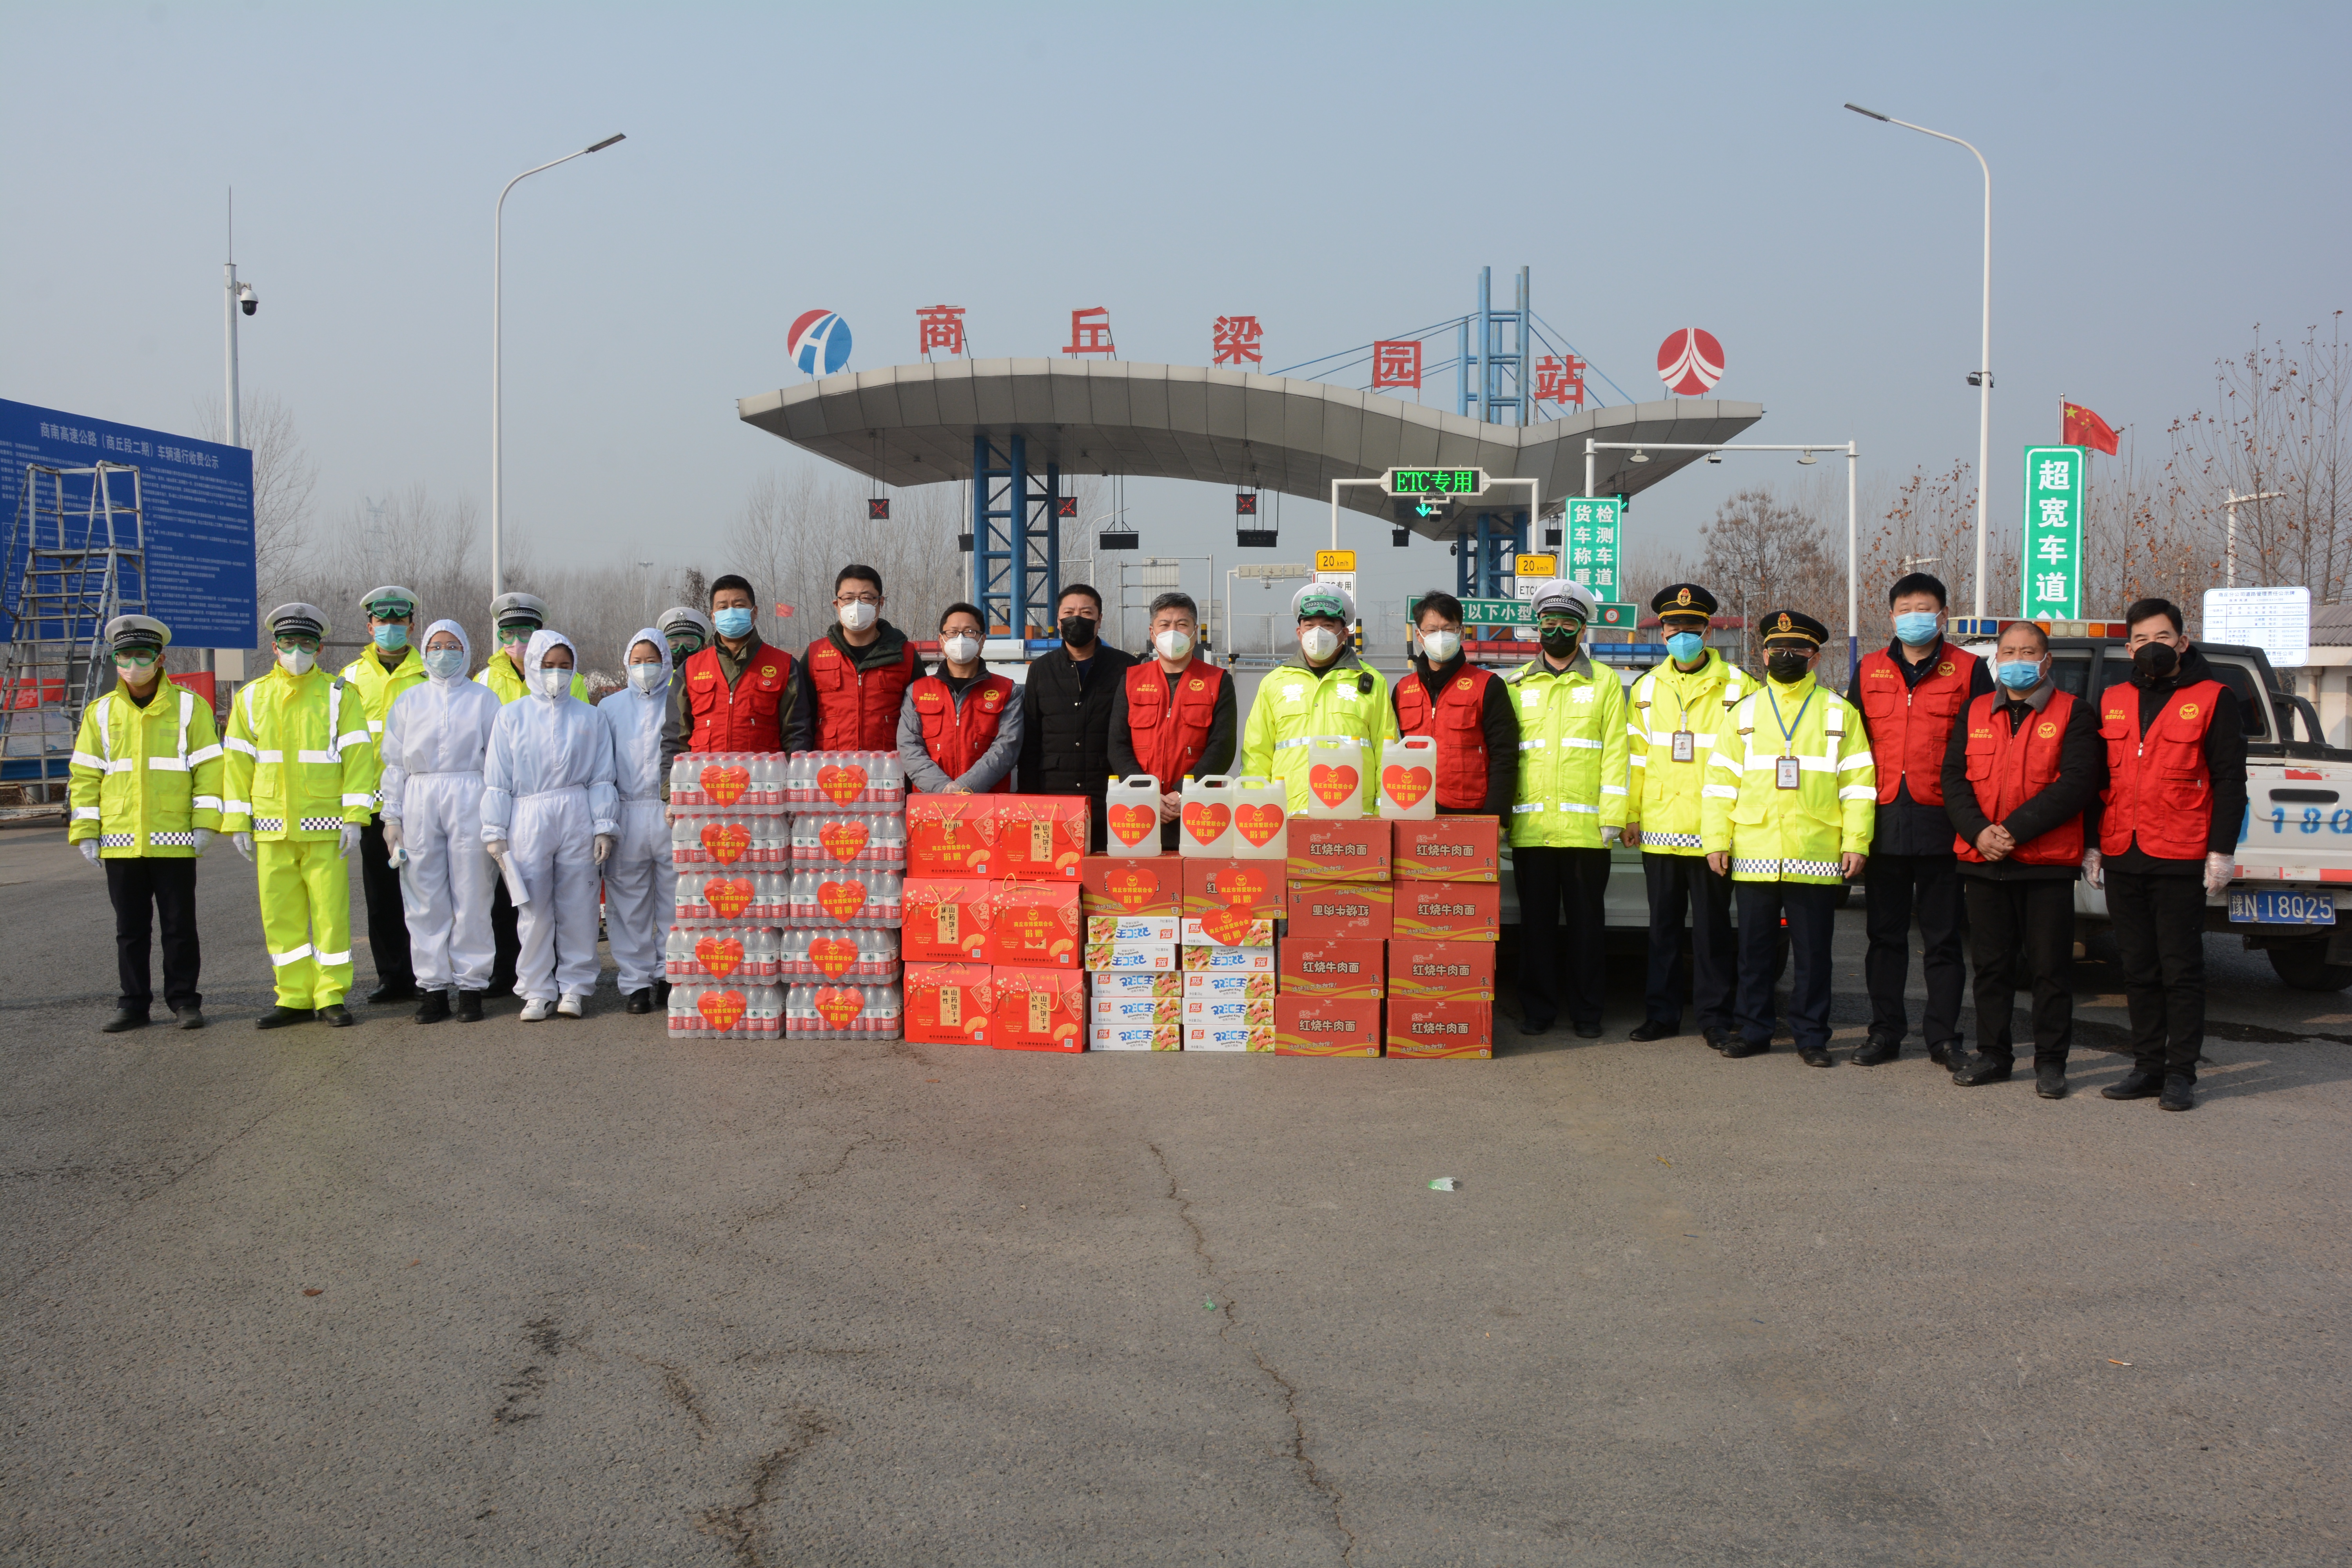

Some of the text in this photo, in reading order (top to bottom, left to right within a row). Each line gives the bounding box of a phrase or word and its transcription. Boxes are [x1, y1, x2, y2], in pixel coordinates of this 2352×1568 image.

[916, 305, 1586, 405] 商丘梁园站
[1396, 470, 1472, 493] ETC专用
[2036, 460, 2070, 602] 超宽车道
[1573, 504, 1592, 586] 货车称重
[1595, 504, 1614, 586] 检测车道
[1323, 555, 1334, 567] 20
[1523, 560, 1534, 571] 20
[1282, 683, 1357, 702] 警 察
[1520, 686, 1595, 708] 警 察
[1324, 791, 1342, 800] 捐赠
[1397, 792, 1416, 801] 捐赠
[1197, 828, 1215, 837] 捐赠
[837, 847, 854, 855] 捐赠
[1310, 843, 1368, 856] 红烧牛肉面
[1416, 844, 1475, 857] 红烧牛肉面
[944, 853, 961, 861] 捐赠
[1124, 895, 1142, 904] 捐赠
[1233, 895, 1251, 903] 捐赠
[835, 906, 852, 914] 捐赠
[1312, 904, 1370, 917] 红烧牛肉面
[1417, 903, 1476, 916] 红烧牛肉面
[1116, 926, 1151, 939] 双汇王
[1209, 919, 1249, 934] 商丘市博爱联合会
[1222, 930, 1241, 942] 捐赠
[1111, 954, 1147, 966] 双汇王
[1210, 954, 1246, 966] 双汇王
[1302, 961, 1360, 974] 红烧牛肉面
[1412, 964, 1470, 976] 红烧牛肉面
[1119, 975, 1155, 987] 双汇王
[1211, 978, 1247, 989] 双汇王
[1120, 1003, 1155, 1014] 双汇王
[1210, 1004, 1247, 1015] 双汇王
[1299, 1019, 1357, 1032] 红烧牛肉面
[1412, 1022, 1469, 1035] 红烧牛肉面
[1118, 1030, 1154, 1041] 双汇王
[1213, 1031, 1249, 1042] 双汇王
